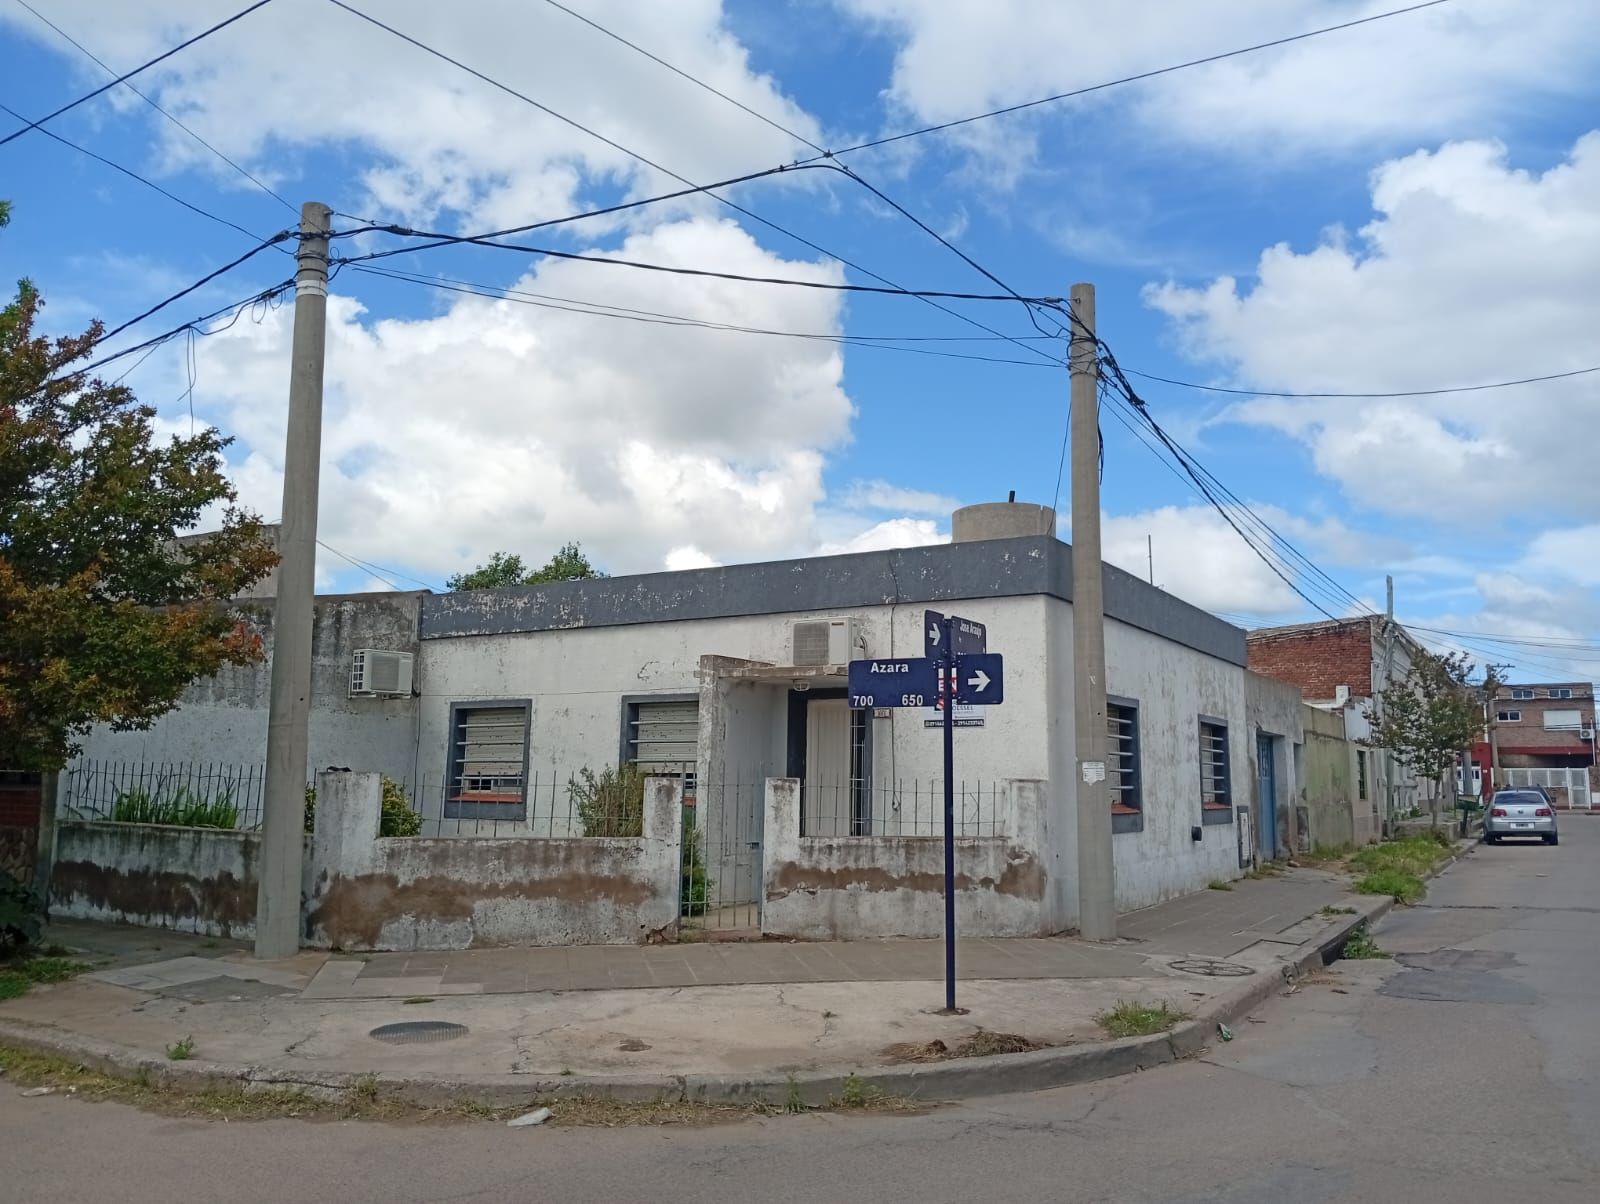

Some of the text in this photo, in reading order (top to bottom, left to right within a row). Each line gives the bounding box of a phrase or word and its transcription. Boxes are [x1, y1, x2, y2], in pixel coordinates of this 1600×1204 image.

[871, 662, 909, 673] Azara
[853, 694, 924, 707] 700 650
